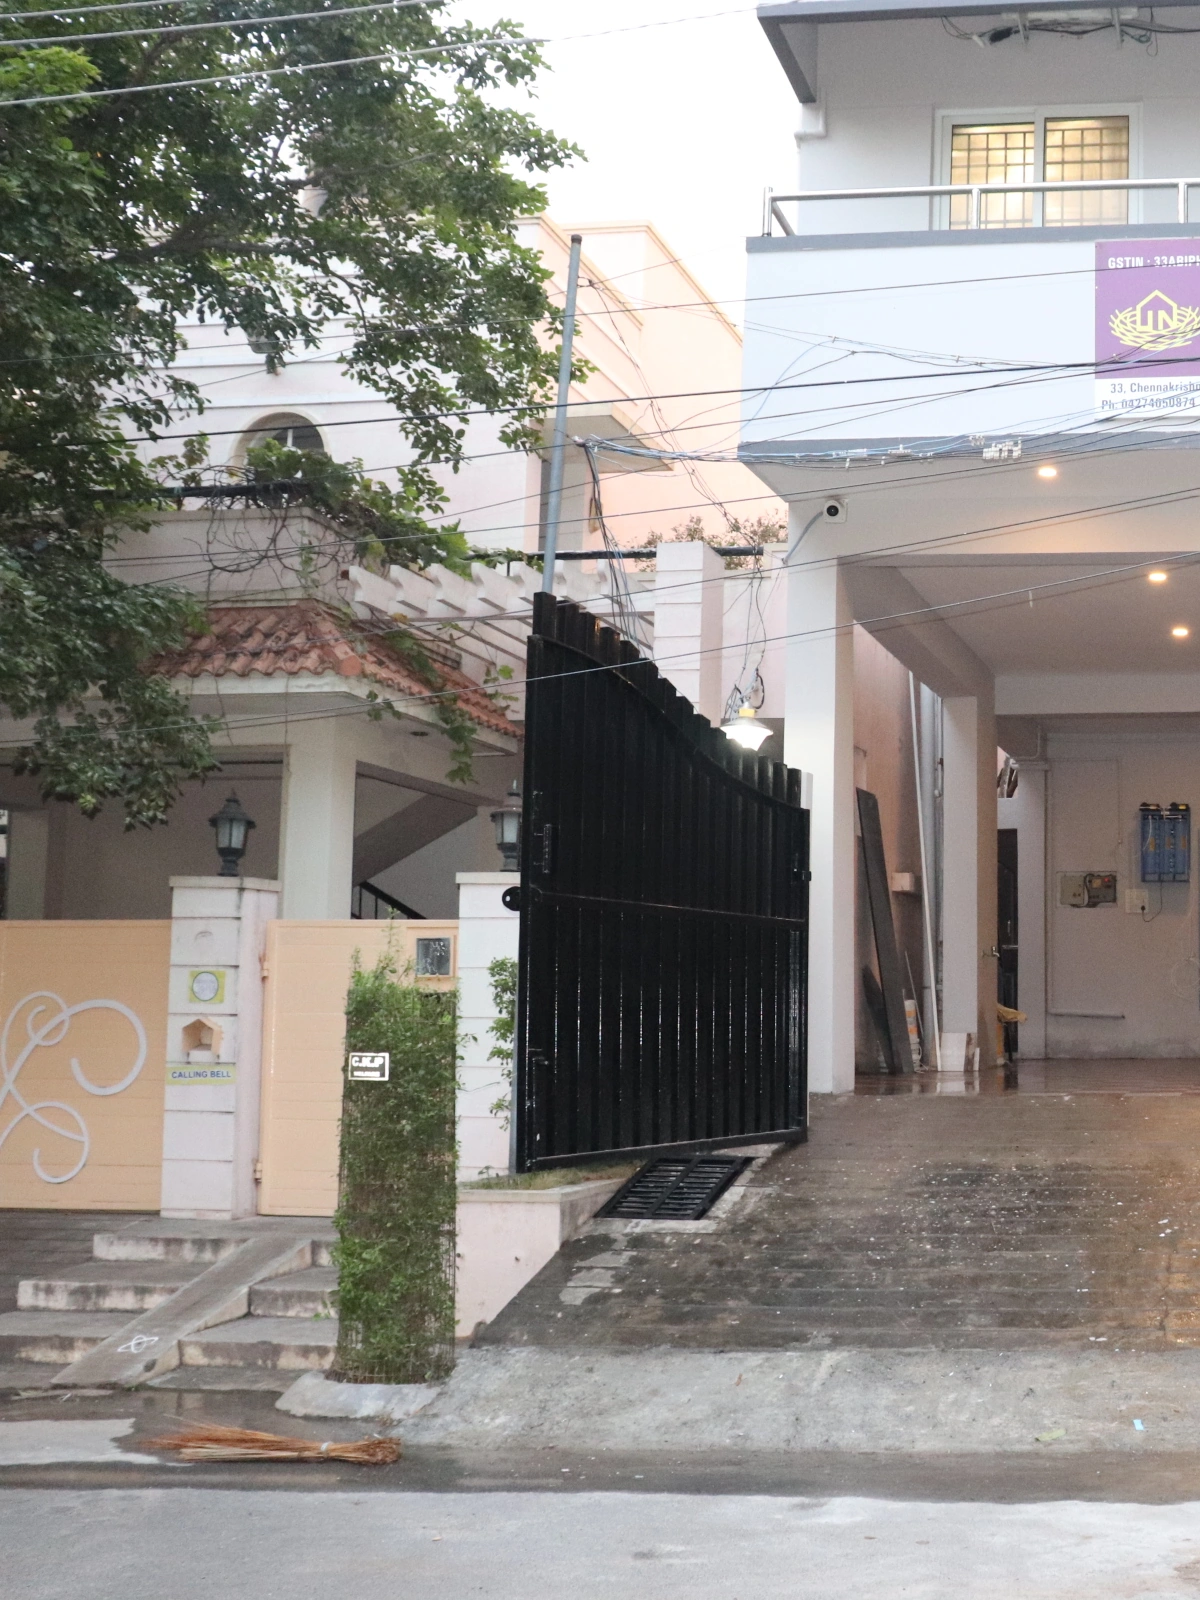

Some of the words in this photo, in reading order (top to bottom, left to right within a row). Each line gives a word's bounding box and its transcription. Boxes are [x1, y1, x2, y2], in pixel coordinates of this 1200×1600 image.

[1108, 256, 1144, 269] GSTIN
[1110, 383, 1126, 394] 33,
[1102, 399, 1118, 410] Ph:
[171, 1070, 208, 1079] CALLING
[210, 1070, 231, 1078] BELL
